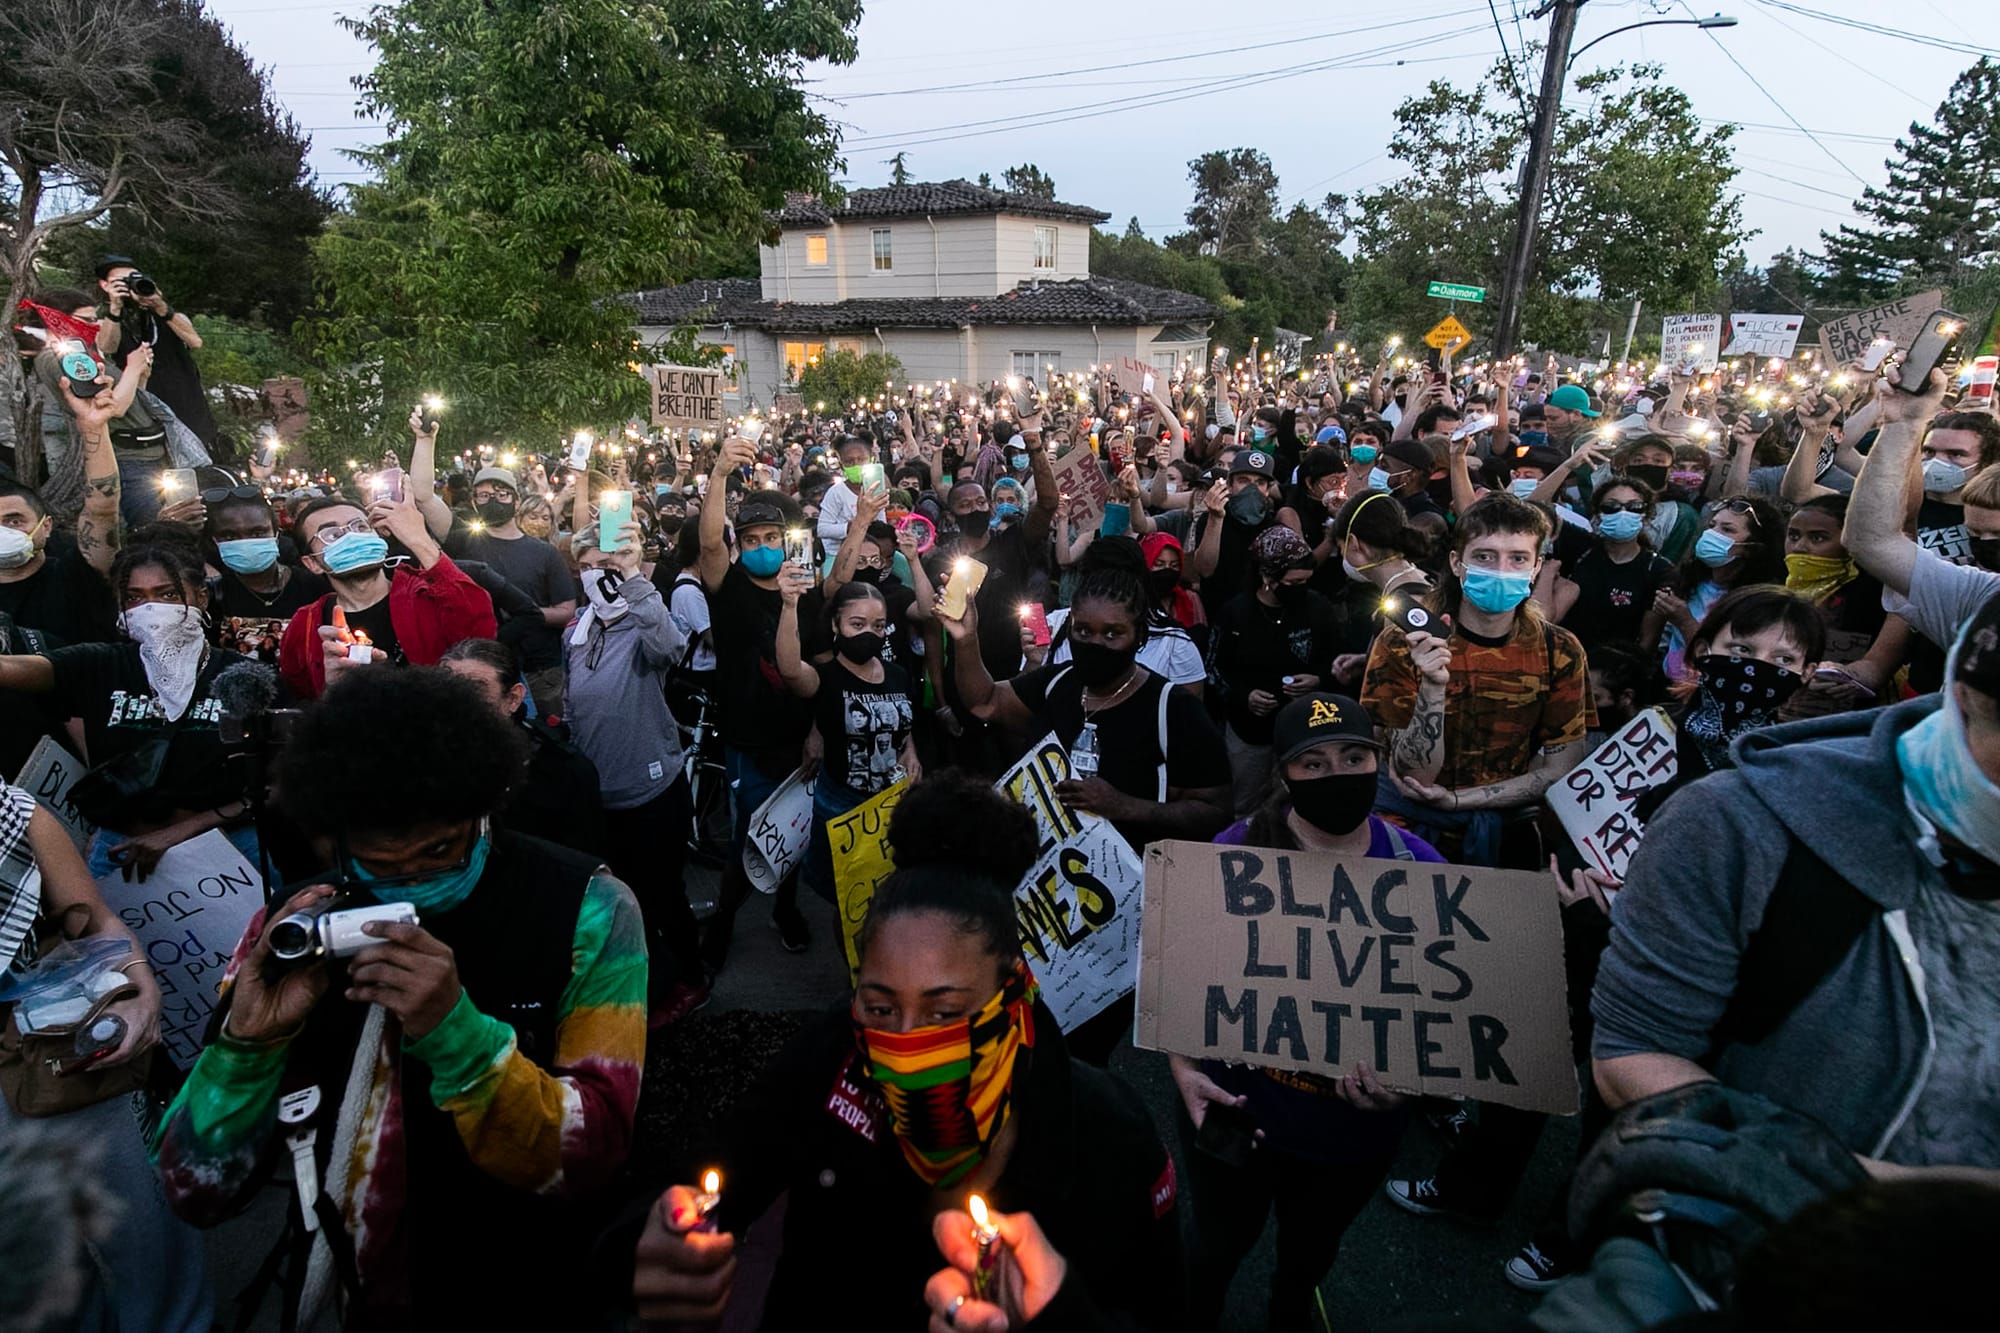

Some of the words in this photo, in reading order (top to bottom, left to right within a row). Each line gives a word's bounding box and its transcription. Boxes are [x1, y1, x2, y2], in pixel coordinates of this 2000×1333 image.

[1440, 285, 1478, 299] Oakmore
[1744, 319, 1784, 332] FUCK
[1824, 317, 1851, 336] WE
[1857, 300, 1913, 325] FIRE
[1828, 322, 1889, 348] BACK
[658, 370, 678, 394] WE
[658, 393, 719, 421] BREATHE
[1566, 768, 1605, 812] OR
[198, 866, 254, 899] NO
[1217, 850, 1490, 942] BLACK
[1243, 920, 1473, 1002] LIVES
[1204, 985, 1519, 1086] MATTER
